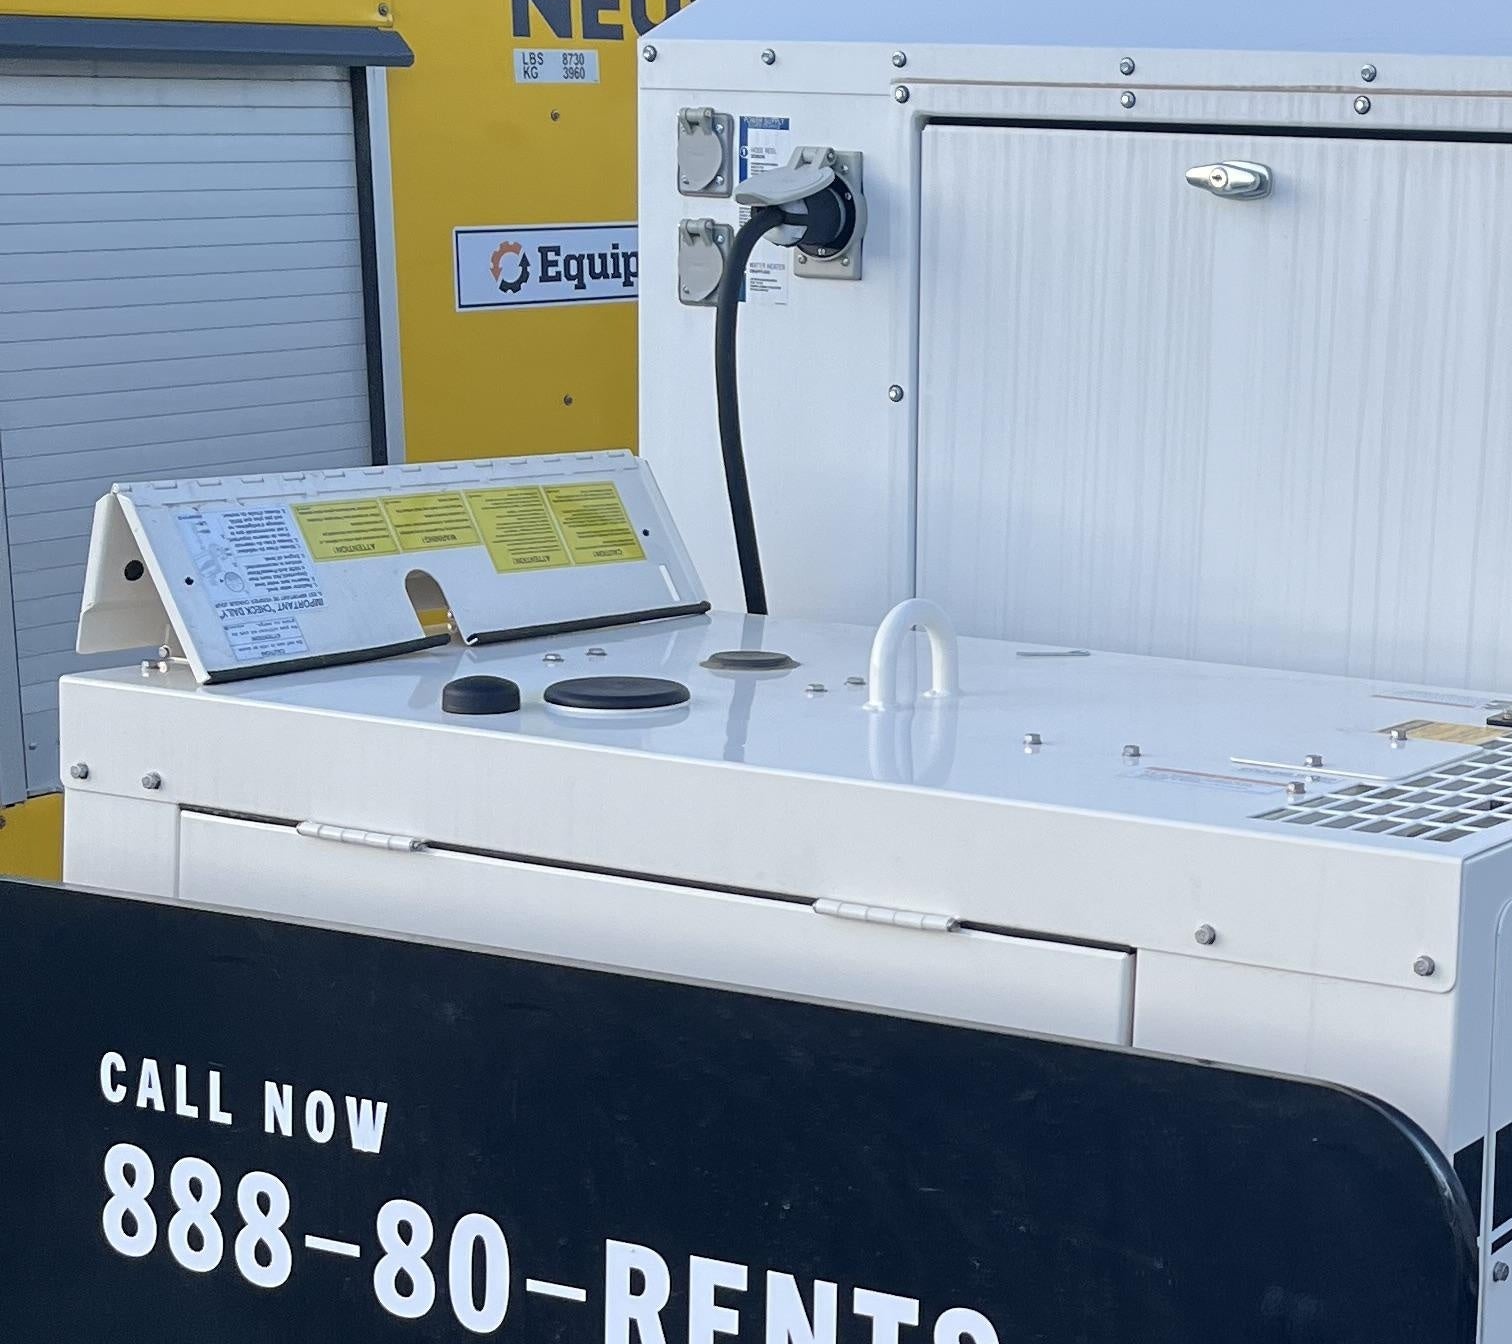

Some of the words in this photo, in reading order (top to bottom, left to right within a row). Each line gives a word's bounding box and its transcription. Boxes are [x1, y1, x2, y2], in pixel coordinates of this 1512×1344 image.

[521, 51, 545, 66] LBS
[561, 53, 585, 67] 8730
[522, 66, 539, 80] KG
[562, 66, 586, 80] 3960
[277, 597, 324, 612] IMPORTANT
[100, 1050, 233, 1126] CALL
[263, 1081, 388, 1154] NOW
